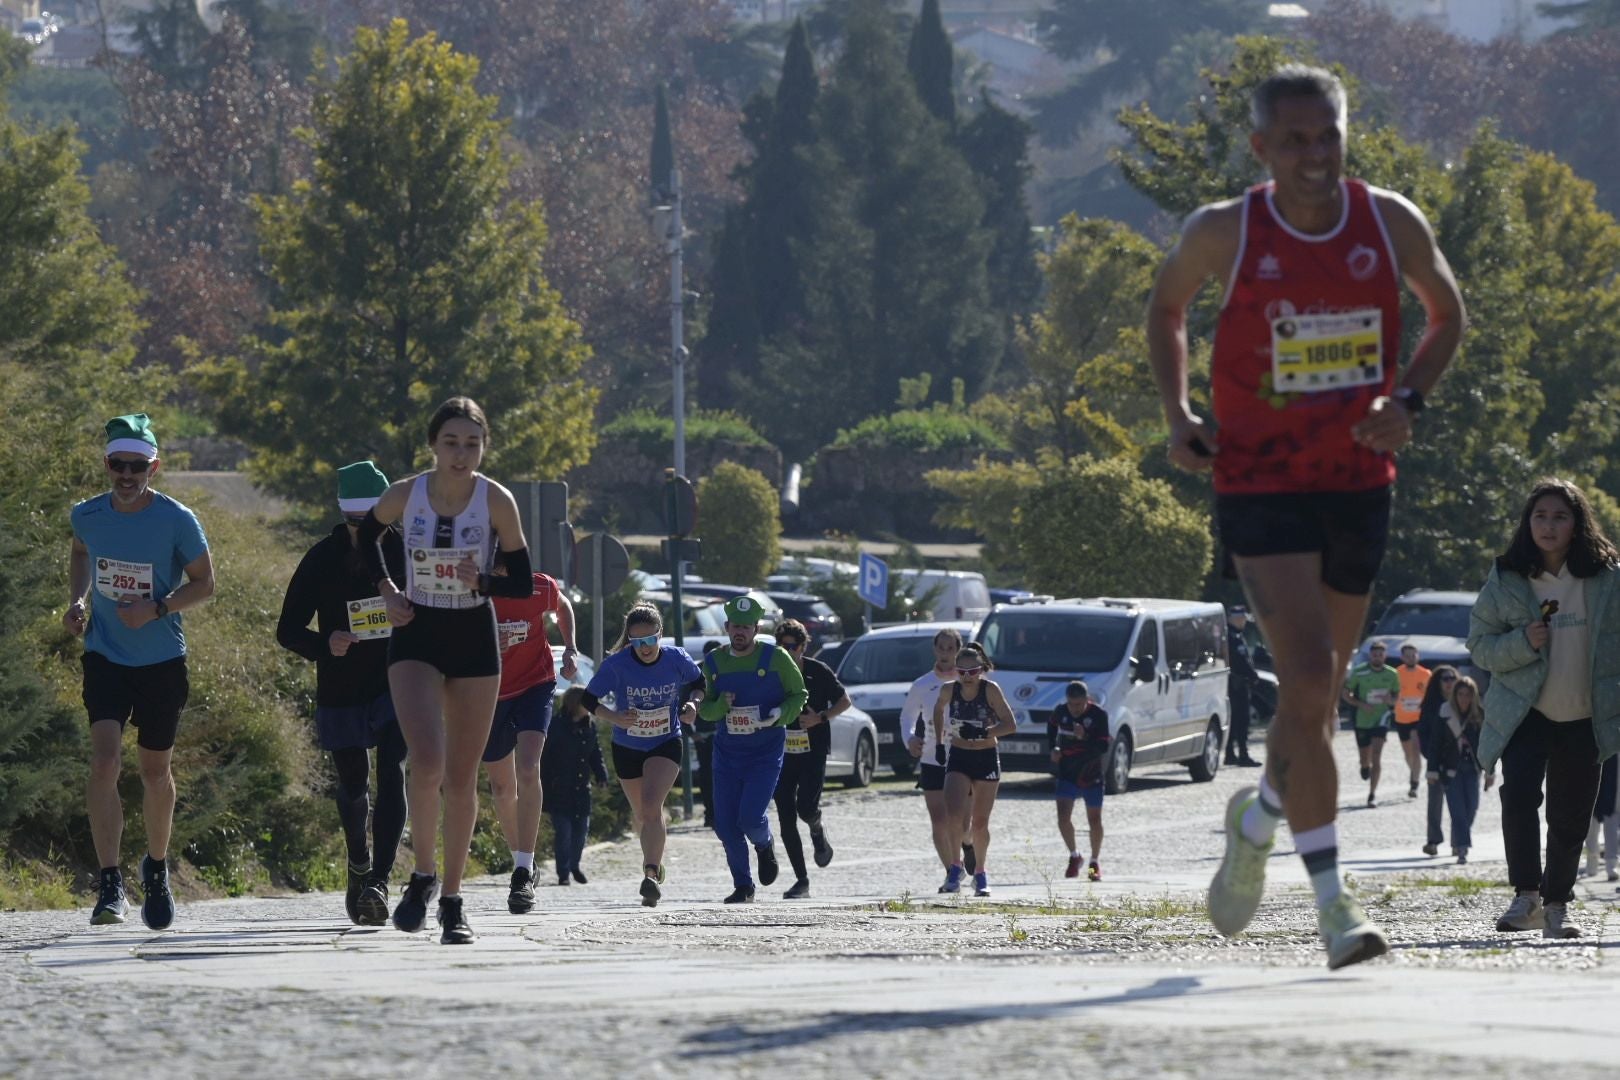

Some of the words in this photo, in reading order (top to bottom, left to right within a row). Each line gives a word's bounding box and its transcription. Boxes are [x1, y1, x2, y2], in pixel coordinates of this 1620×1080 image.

[1306, 341, 1352, 364] 1806
[112, 575, 136, 590] 252
[866, 560, 882, 595] P
[740, 600, 747, 609] L
[366, 612, 387, 625] 166
[626, 682, 676, 697] BADAJOZ
[638, 719, 660, 728] 2245
[732, 716, 749, 725] 696
